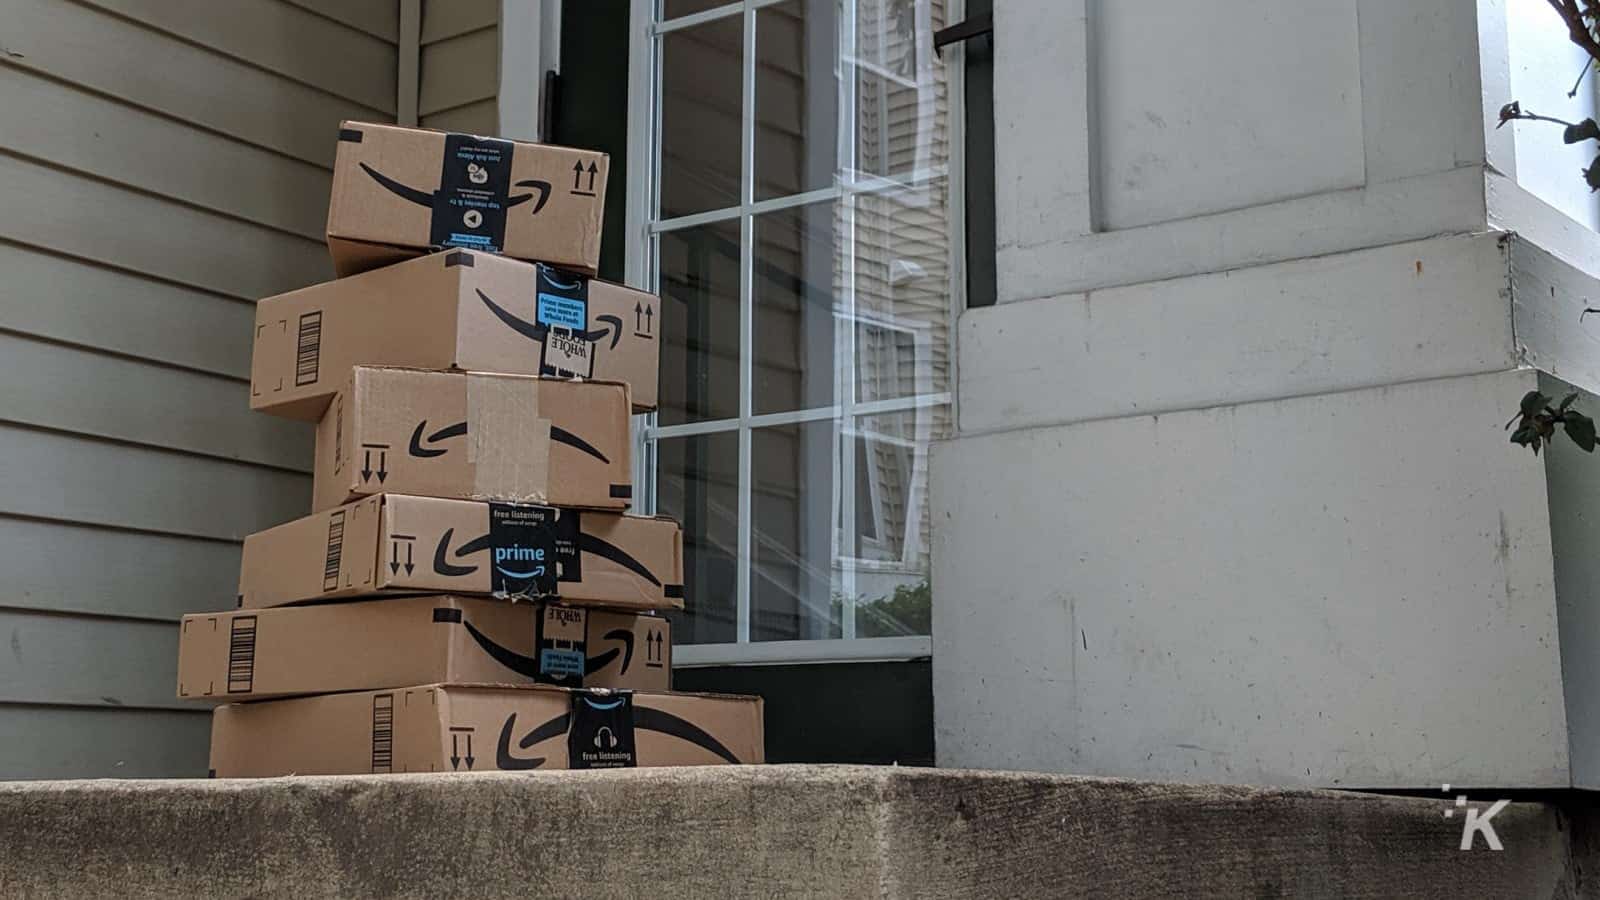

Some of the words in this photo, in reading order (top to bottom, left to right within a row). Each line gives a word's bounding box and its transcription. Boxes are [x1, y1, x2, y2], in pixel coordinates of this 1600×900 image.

[551, 336, 587, 358] WHOLE
[493, 509, 510, 518] free
[511, 510, 545, 521] listening
[495, 543, 545, 564] prime
[582, 751, 598, 760] free
[598, 751, 631, 761] listening
